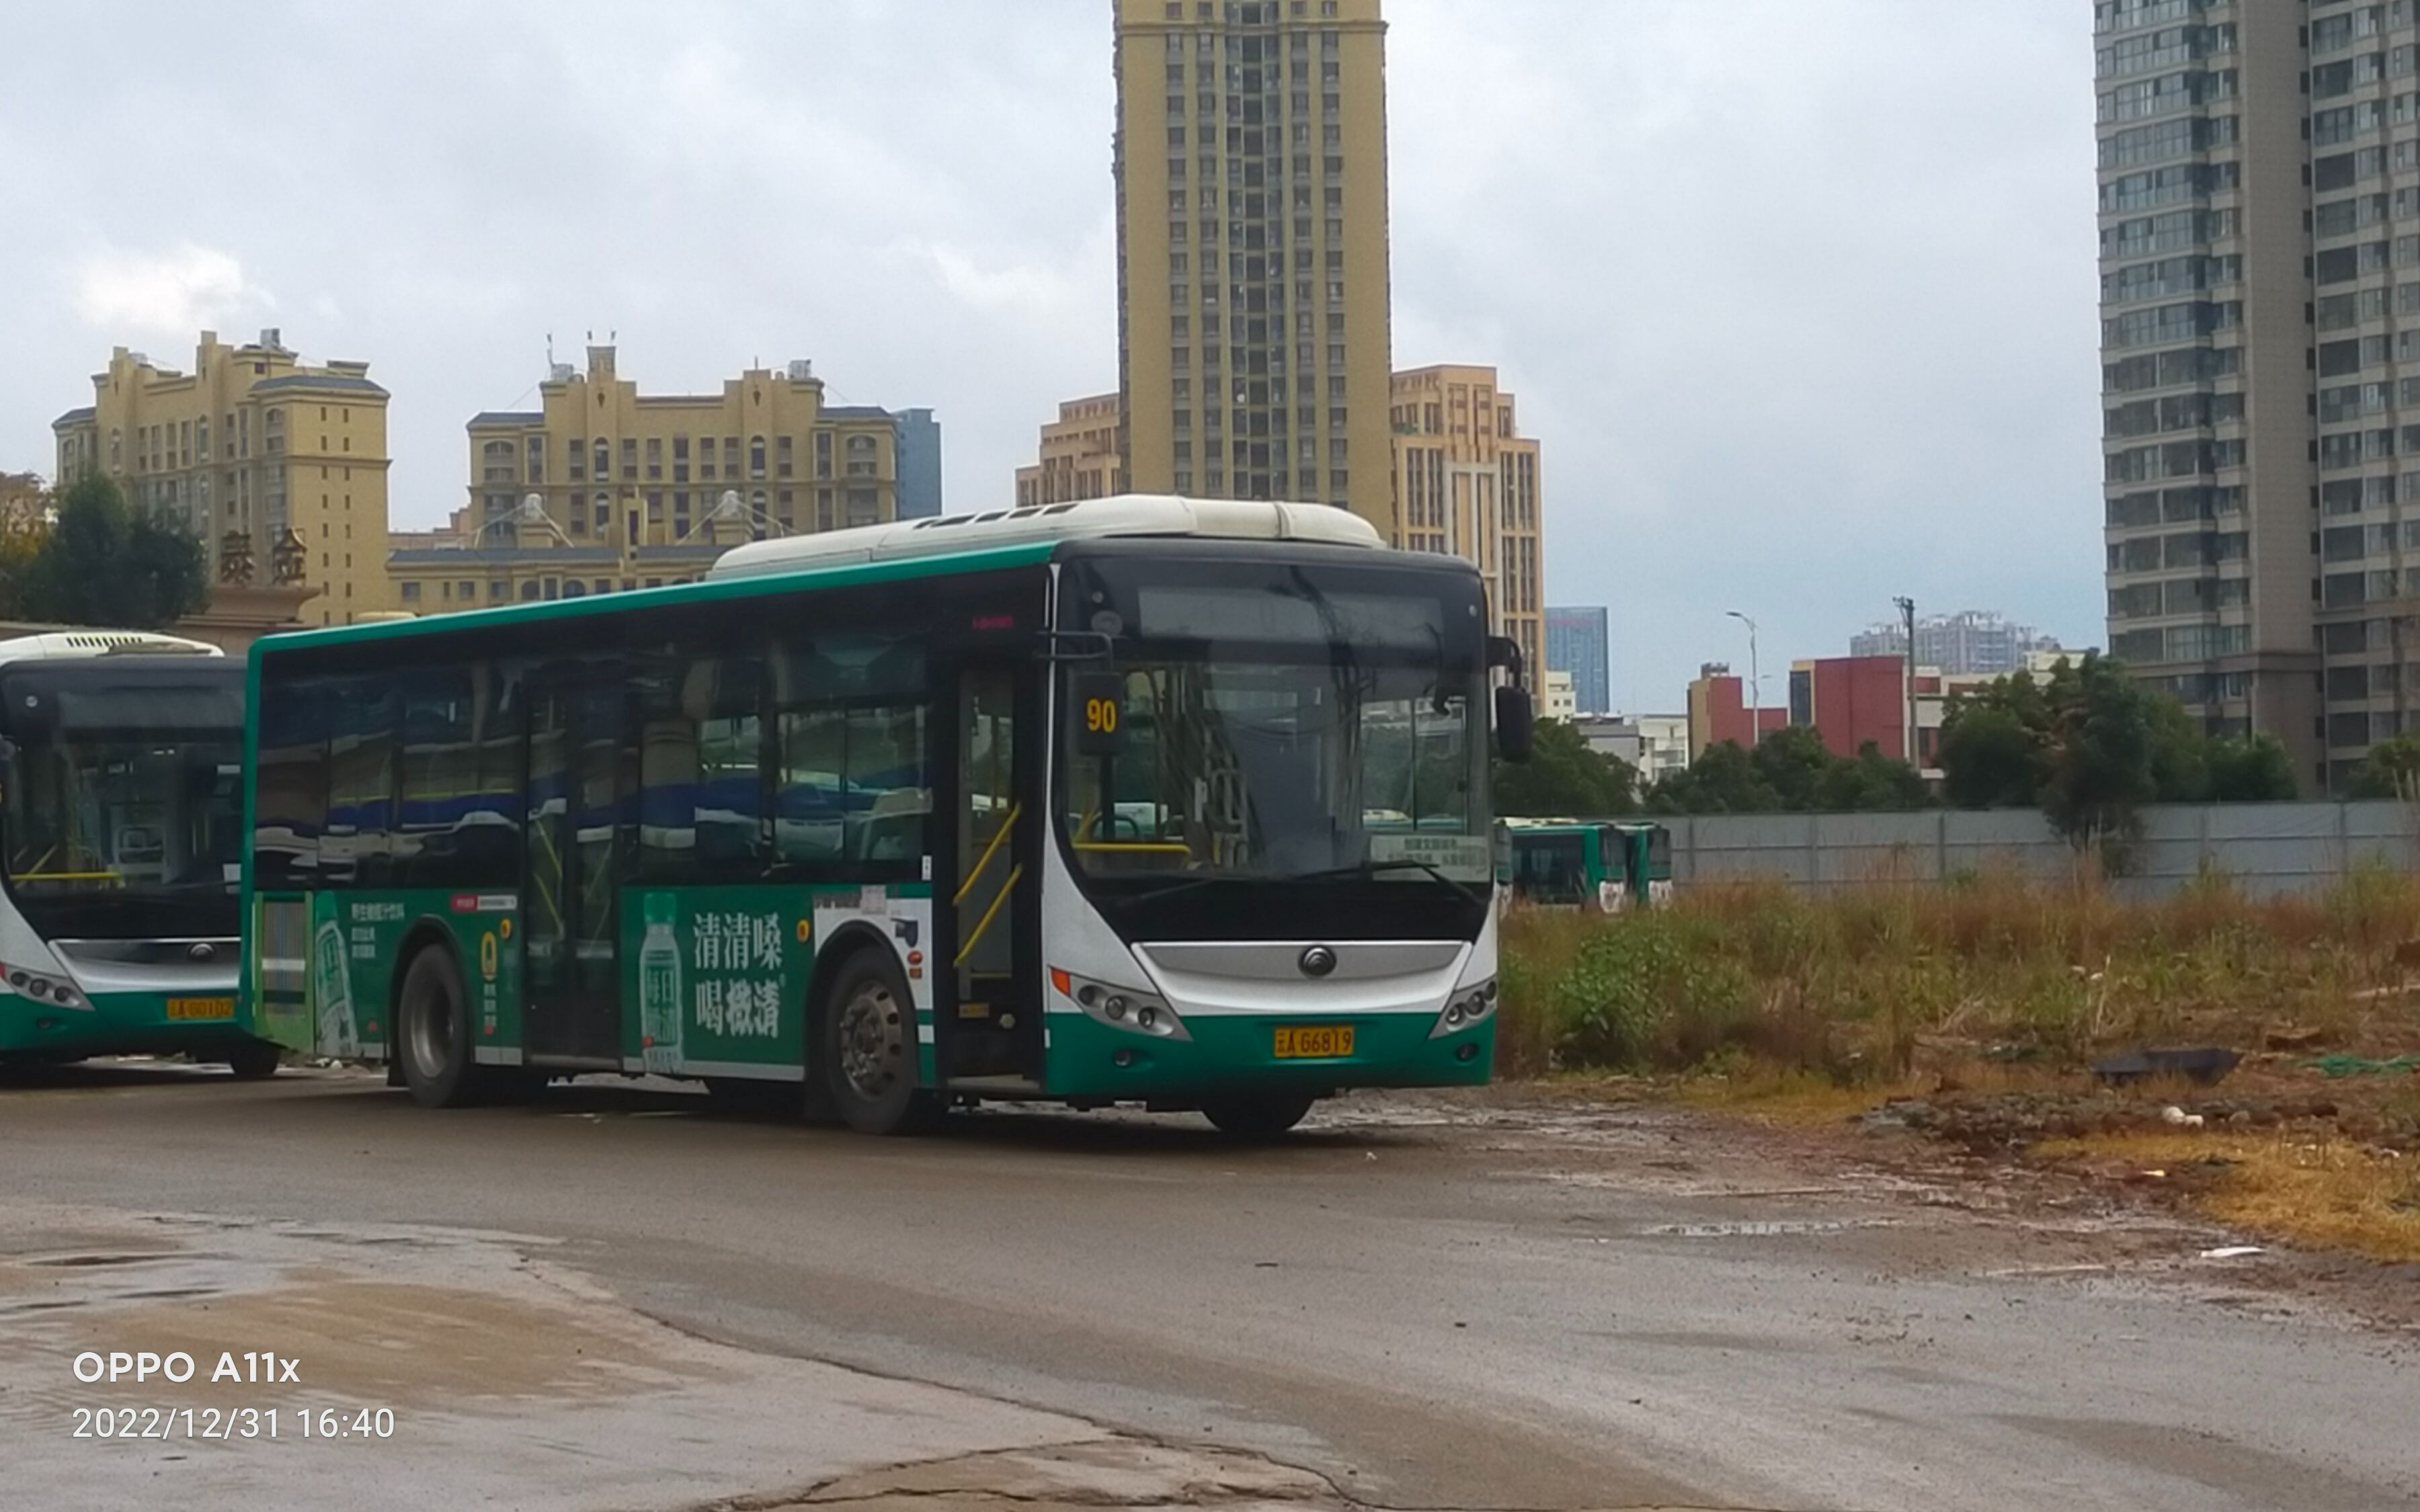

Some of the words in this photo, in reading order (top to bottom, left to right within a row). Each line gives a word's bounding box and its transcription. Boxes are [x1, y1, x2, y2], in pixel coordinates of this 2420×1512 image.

[1086, 698, 1117, 733] 90
[692, 911, 783, 970] 清清嗓
